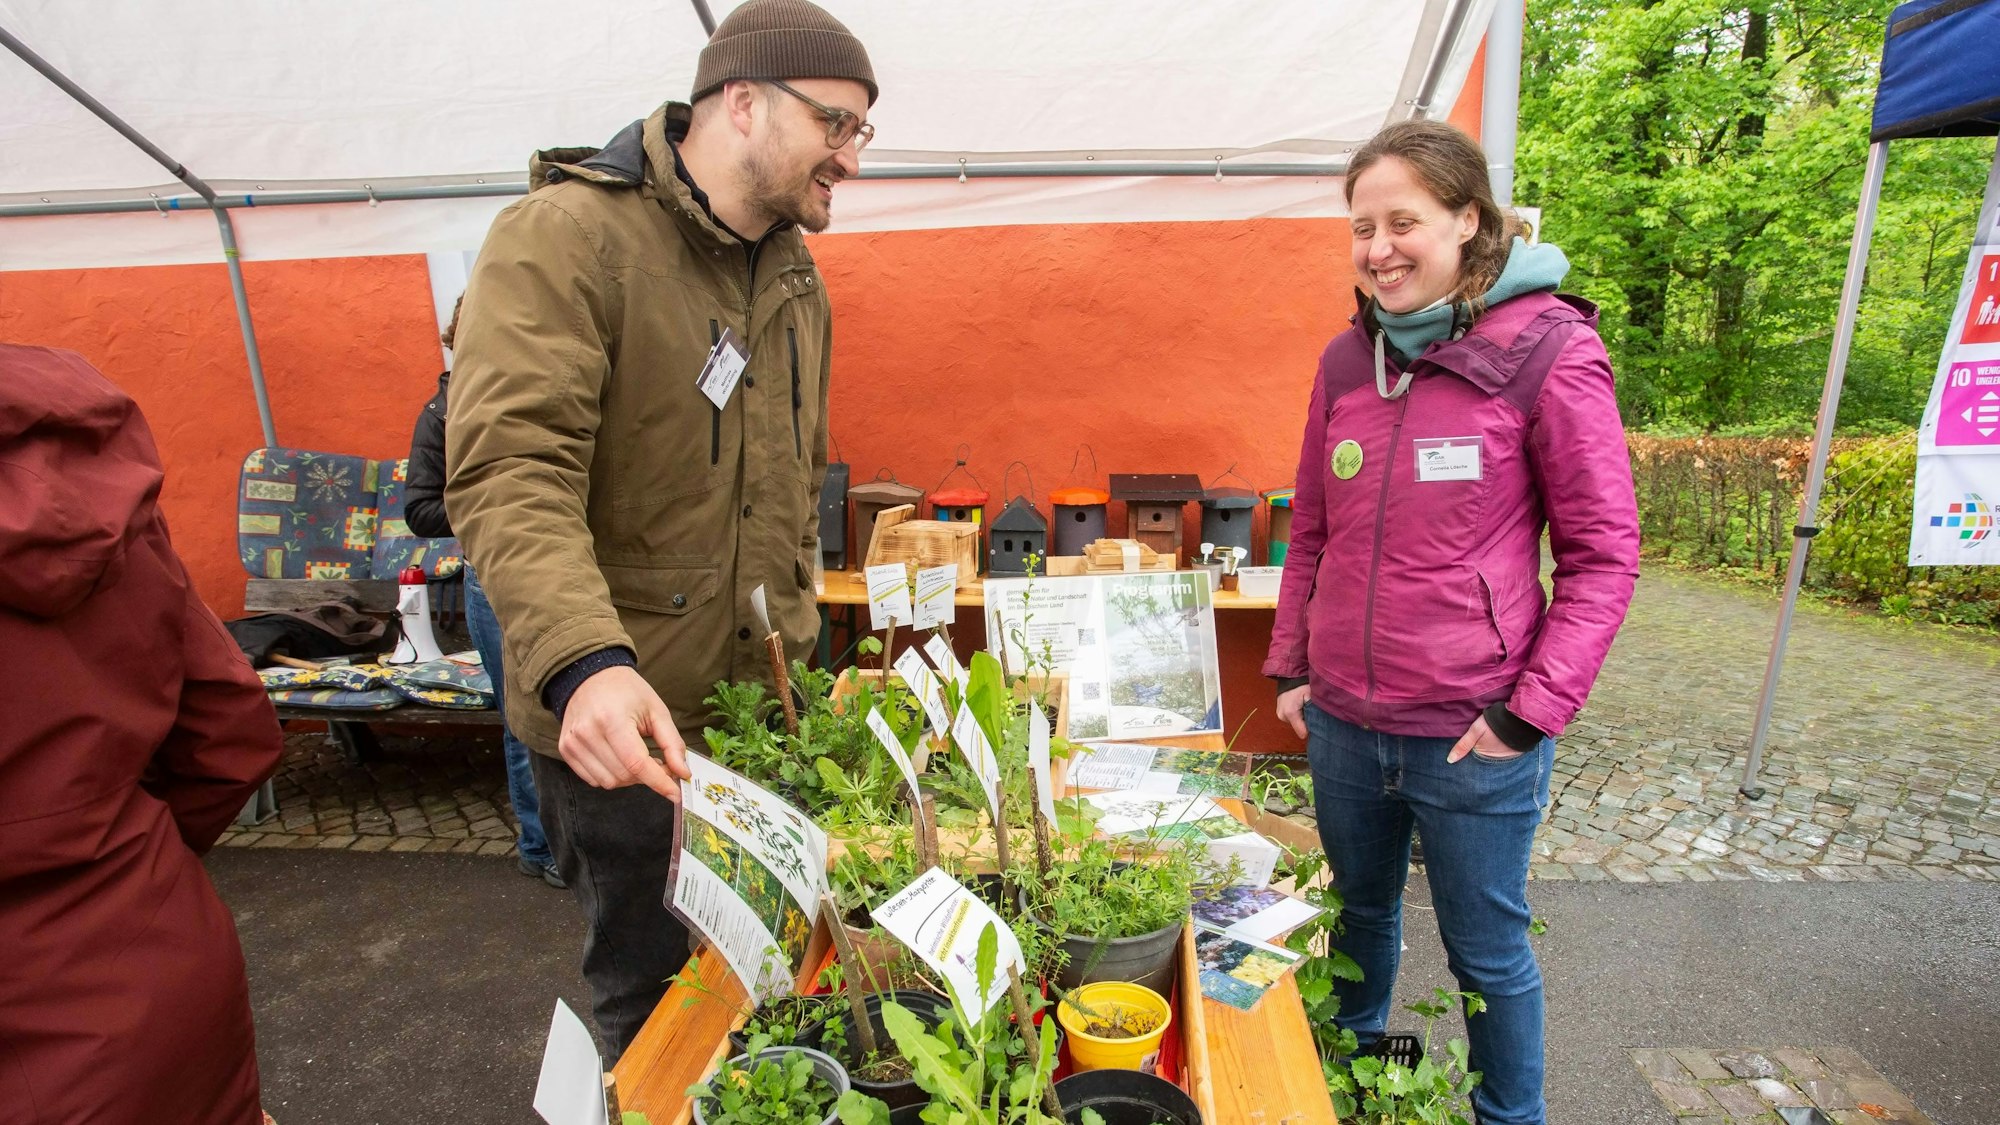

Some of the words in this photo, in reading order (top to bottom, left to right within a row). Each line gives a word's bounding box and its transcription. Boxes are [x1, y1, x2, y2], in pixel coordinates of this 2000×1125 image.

[1989, 261, 1998, 282] 1
[1951, 367, 1971, 388] 10
[1112, 583, 1192, 600] Programm
[939, 946, 948, 962] echt
